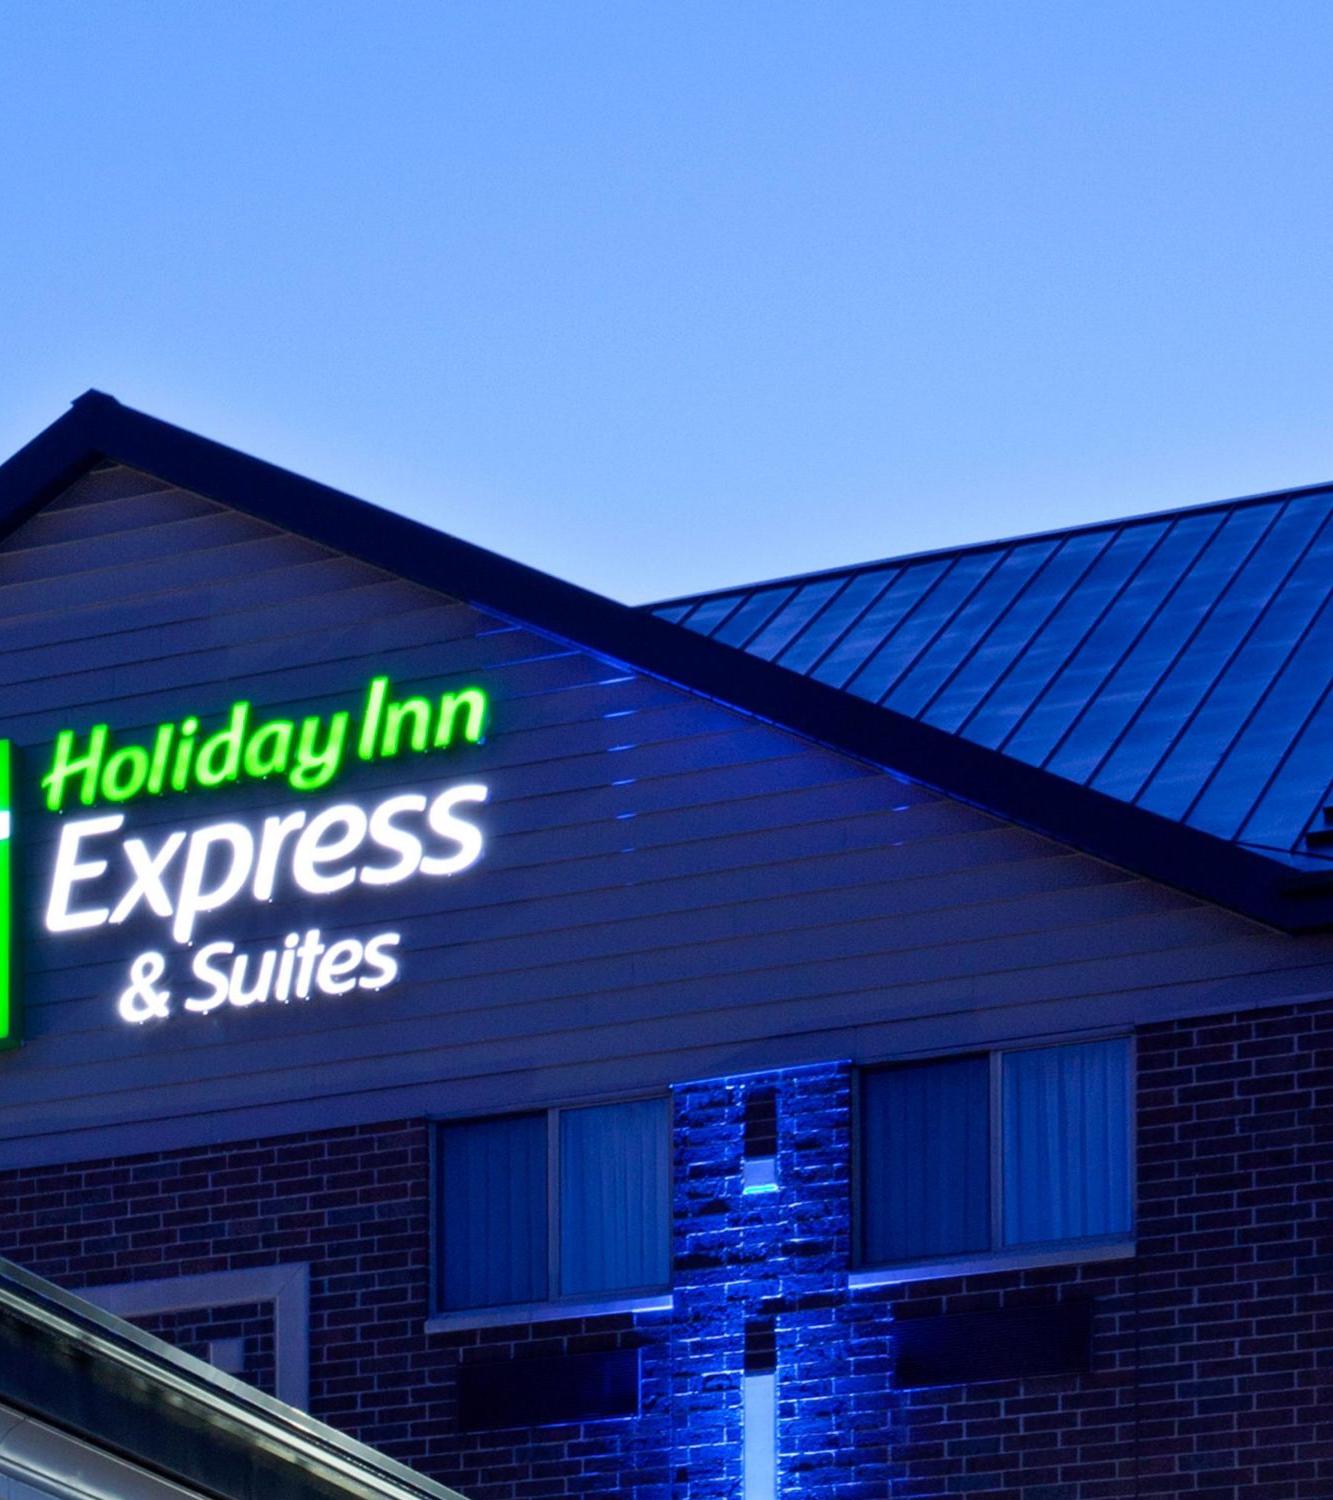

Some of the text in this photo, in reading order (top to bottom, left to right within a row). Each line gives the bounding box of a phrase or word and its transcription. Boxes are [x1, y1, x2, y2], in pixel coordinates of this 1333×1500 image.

[41, 676, 487, 812] Holiday Inn
[45, 784, 489, 945] Express
[118, 929, 400, 1023] & Suites
